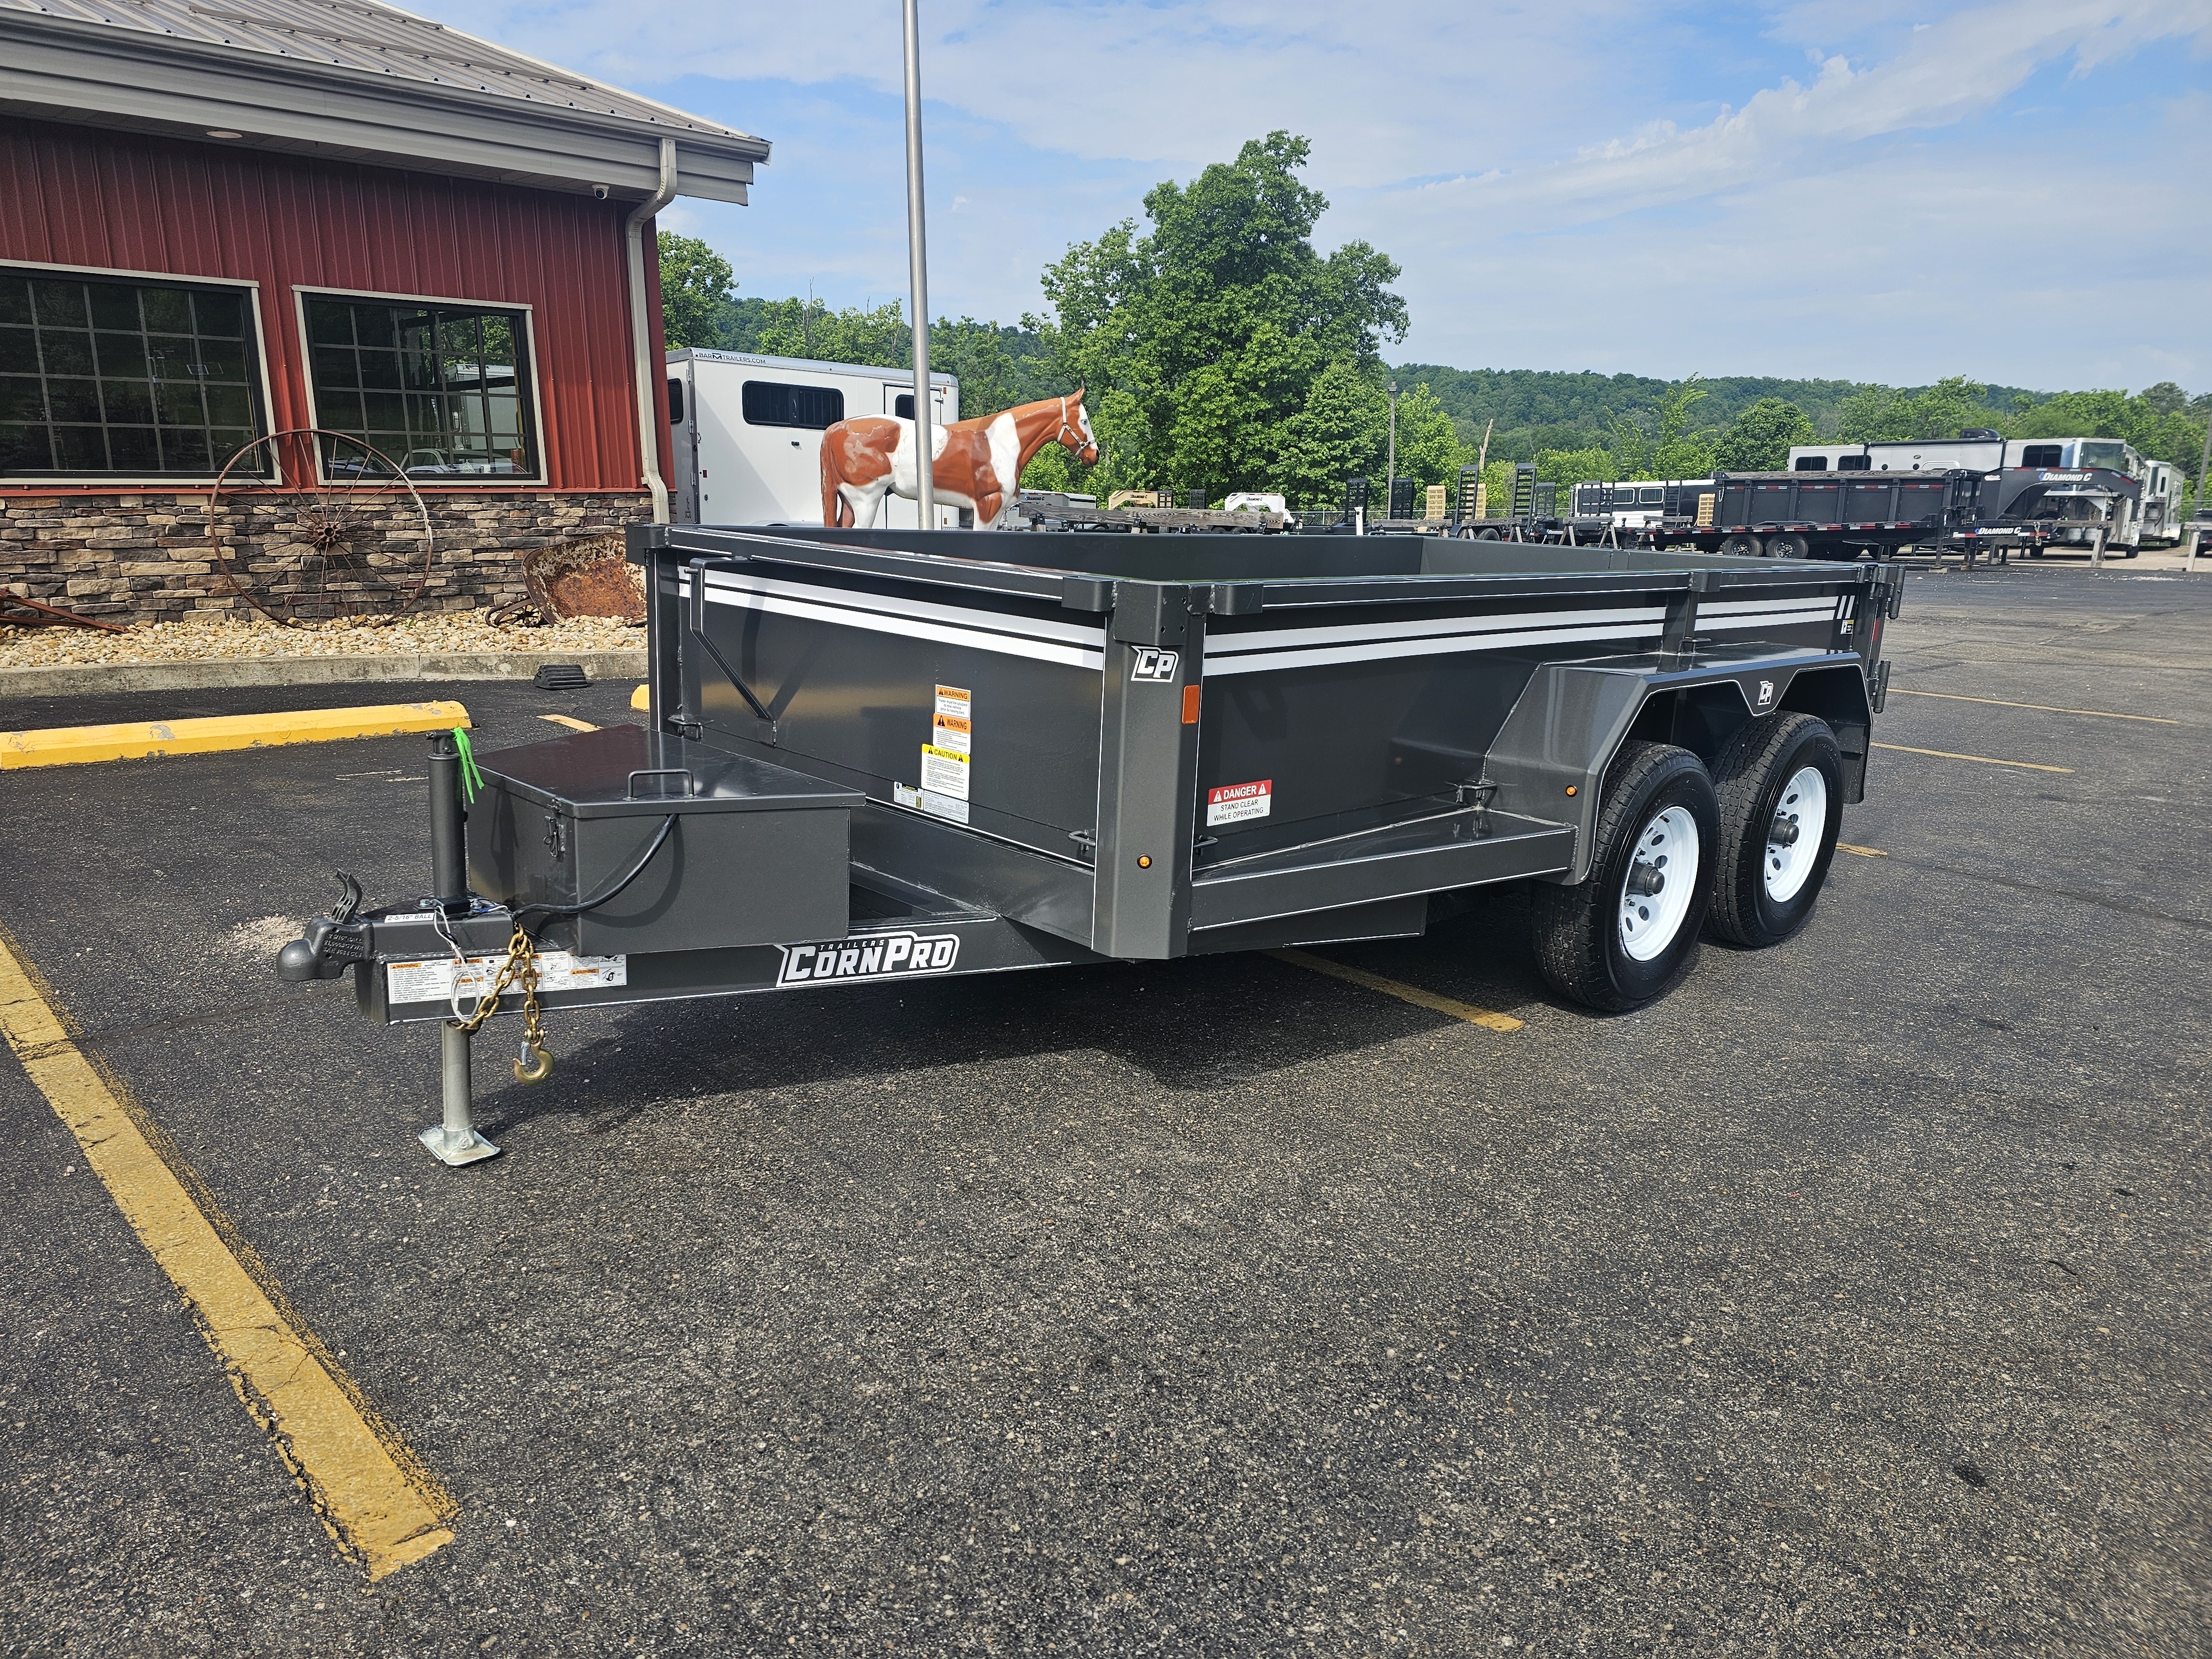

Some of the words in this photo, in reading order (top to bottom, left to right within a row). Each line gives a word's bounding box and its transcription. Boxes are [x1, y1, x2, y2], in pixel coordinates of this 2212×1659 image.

[2042, 472, 2083, 482] DIAMOND
[2083, 472, 2093, 482] C
[1136, 650, 1175, 679] CP
[943, 689, 968, 700] WARNING
[947, 718, 967, 730] WARNING
[934, 749, 957, 760] CAUTION
[1223, 785, 1257, 800] DANGER
[1220, 802, 1239, 812] STAND
[1240, 799, 1258, 808] CLEAR
[1214, 812, 1232, 822] WHILE
[1233, 807, 1264, 818] OPERATING
[820, 938, 885, 951] TRAILERS
